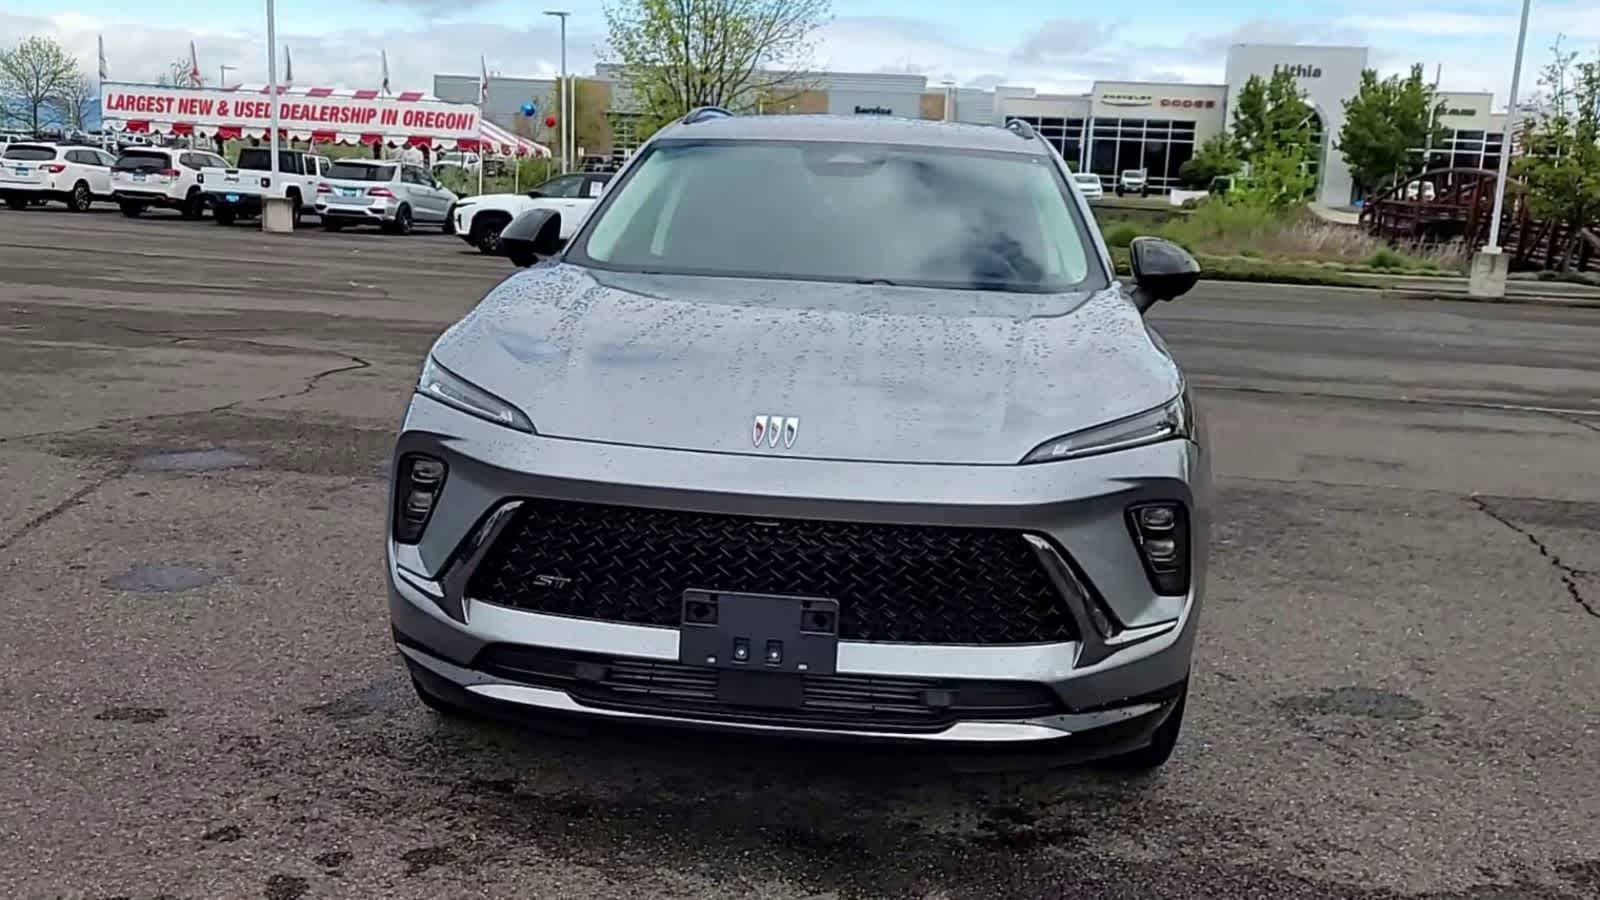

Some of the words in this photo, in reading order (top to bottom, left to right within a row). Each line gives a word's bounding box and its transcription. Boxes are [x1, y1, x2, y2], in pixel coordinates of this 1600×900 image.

[106, 94, 175, 114] LARGEST
[178, 98, 214, 115] NEW
[217, 100, 229, 117] &
[279, 103, 378, 125] DEALERSHIP
[381, 108, 399, 126] IN
[403, 110, 475, 130] OREGON!
[855, 105, 892, 115] Service
[533, 574, 572, 588] ST
